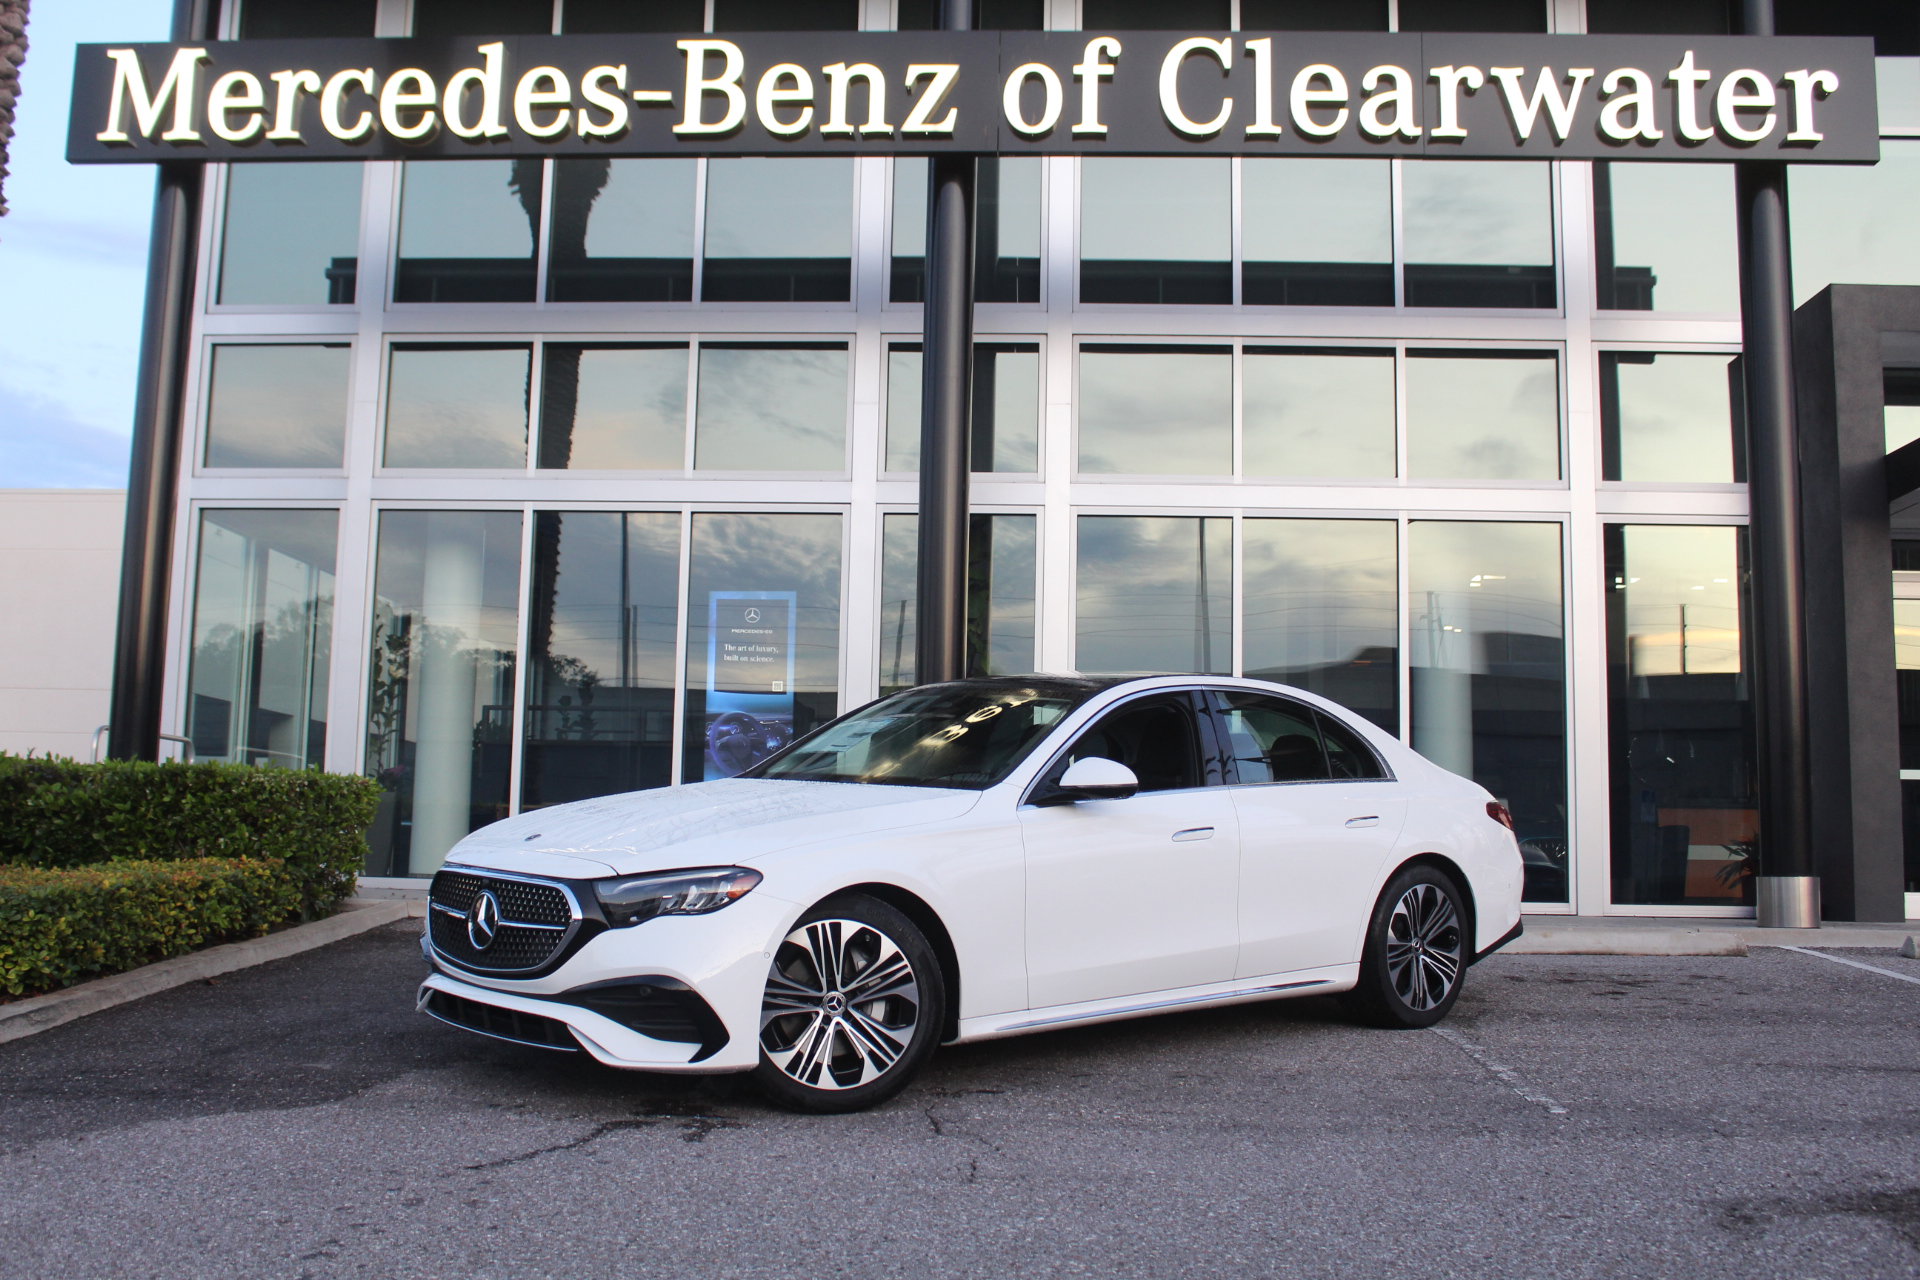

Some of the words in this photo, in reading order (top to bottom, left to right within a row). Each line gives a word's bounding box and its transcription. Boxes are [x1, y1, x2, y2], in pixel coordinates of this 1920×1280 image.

[97, 40, 960, 141] Mercedes-Benz
[1003, 37, 1122, 134] of
[1158, 37, 1840, 142] Clearwater
[724, 643, 736, 651] The
[750, 655, 775, 663] science.
